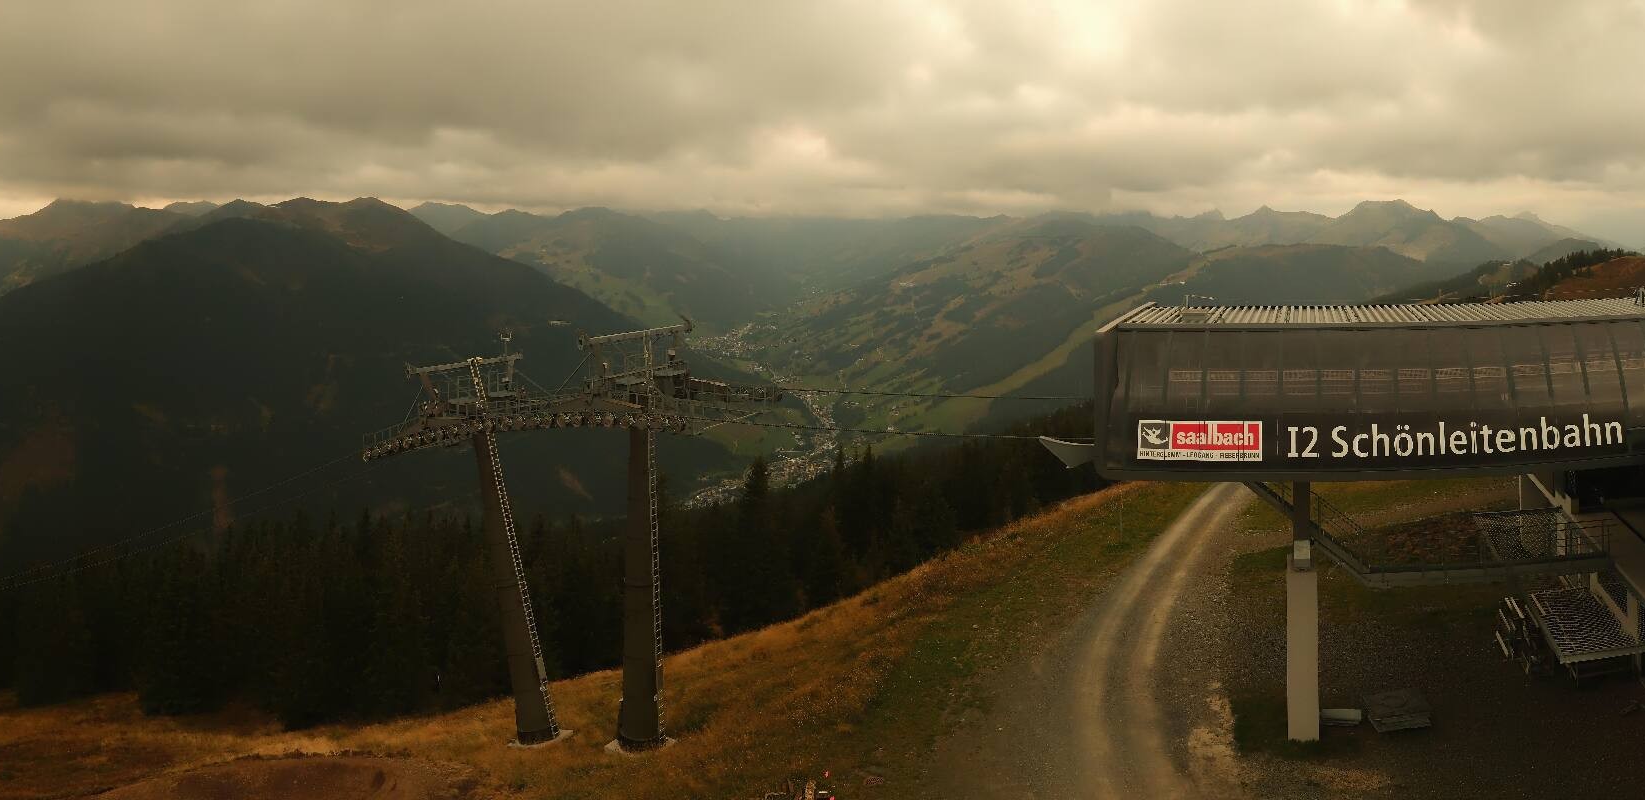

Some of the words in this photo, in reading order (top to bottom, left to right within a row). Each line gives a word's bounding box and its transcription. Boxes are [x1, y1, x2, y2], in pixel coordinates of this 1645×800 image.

[1176, 423, 1254, 446] saalbach
[1287, 426, 1319, 458] I2
[1331, 413, 1623, 458] Schönleitenbahn
